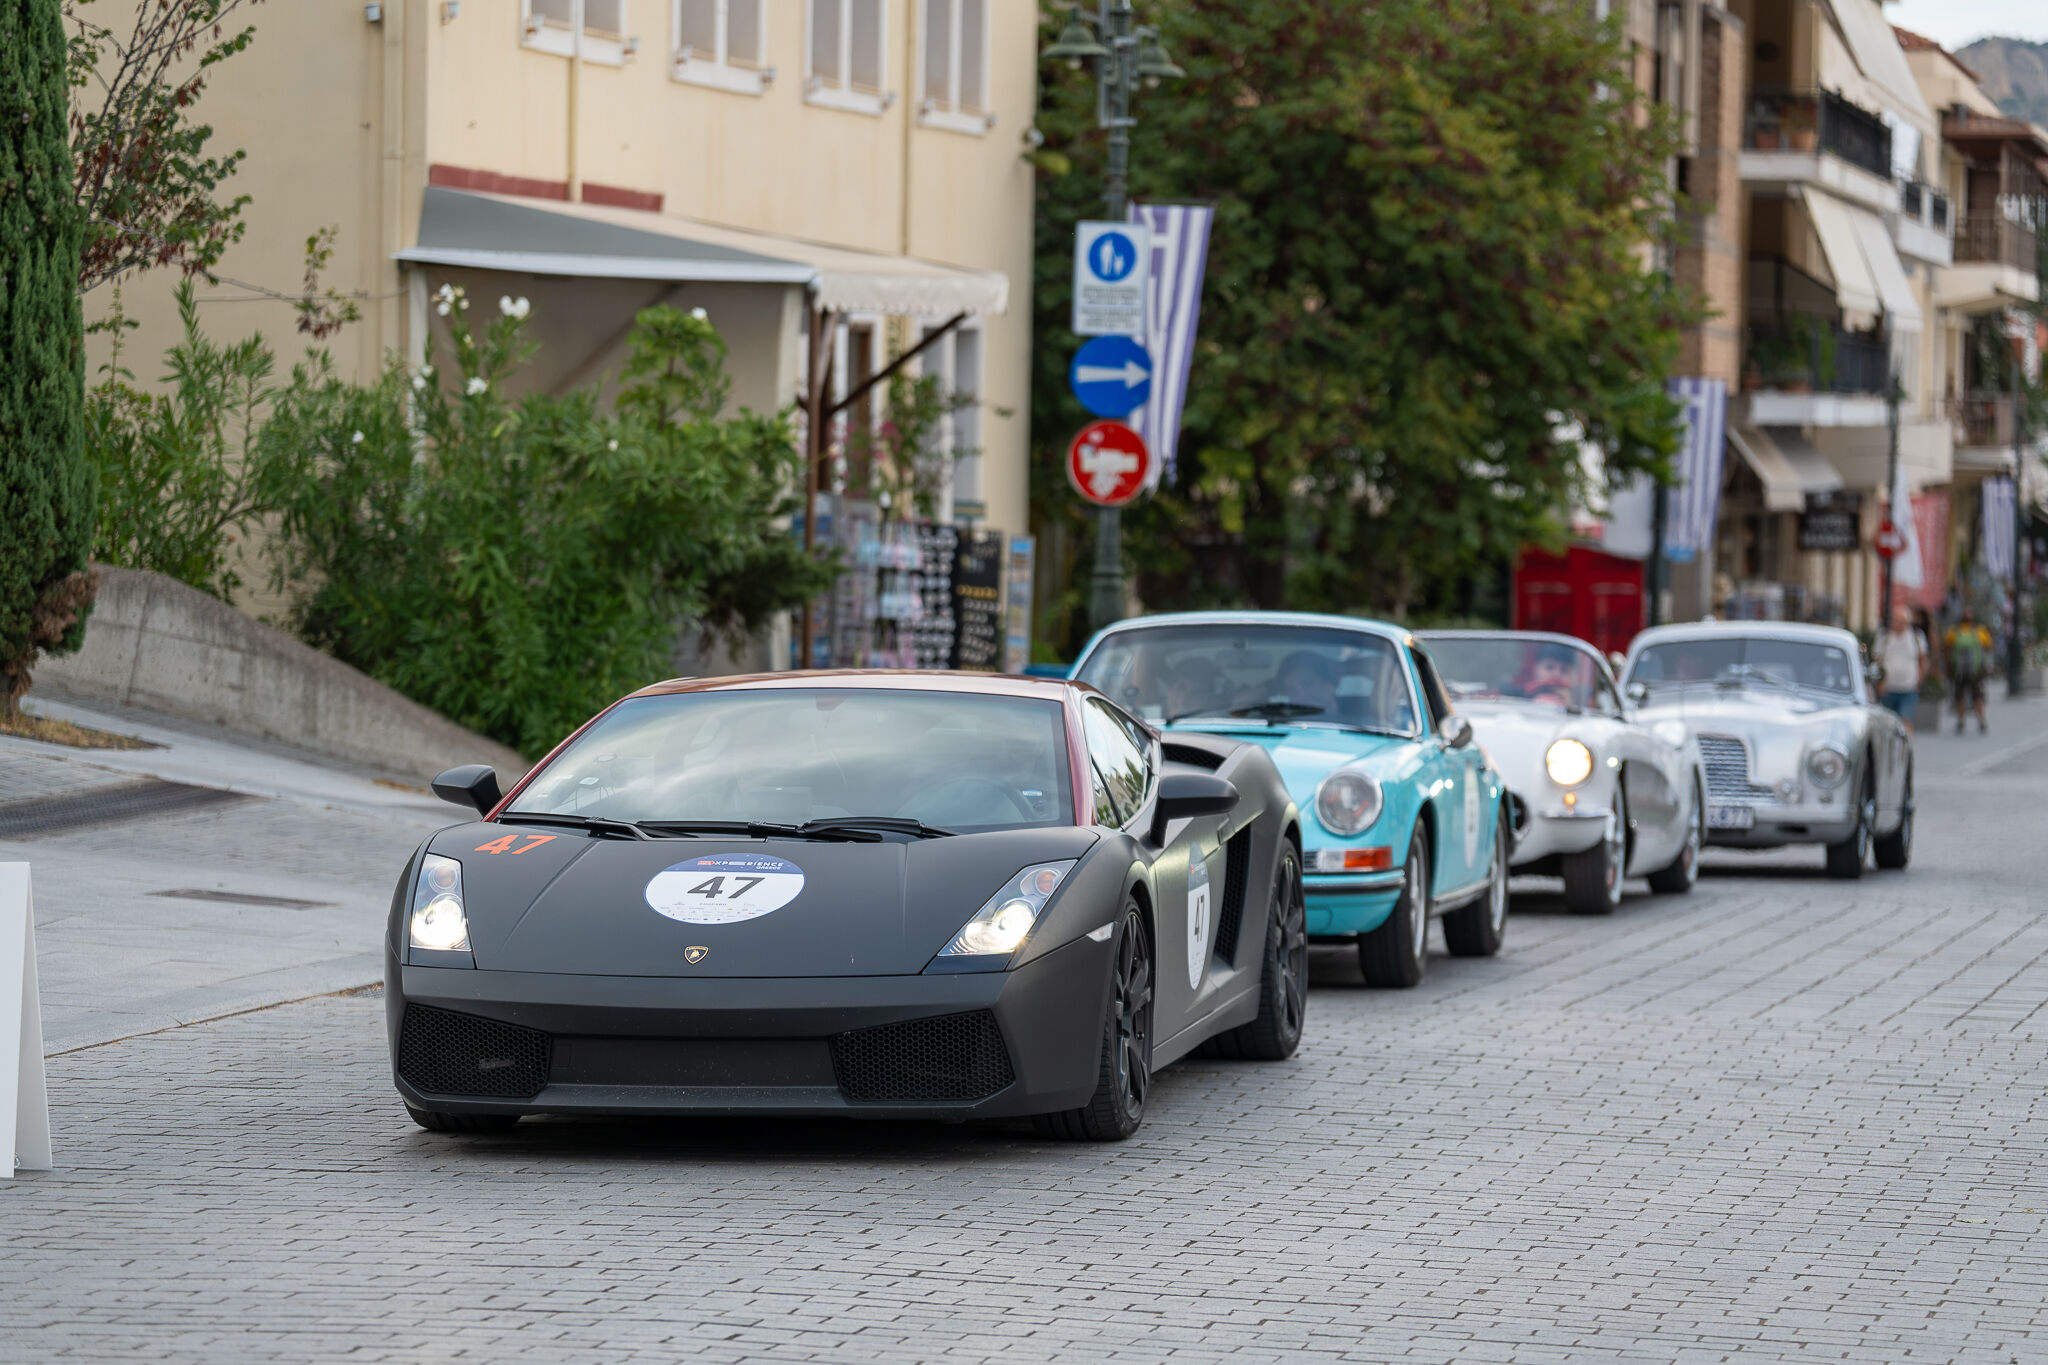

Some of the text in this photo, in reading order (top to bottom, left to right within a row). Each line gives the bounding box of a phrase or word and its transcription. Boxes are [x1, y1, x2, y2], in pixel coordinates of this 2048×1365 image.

[474, 834, 558, 855] 47
[687, 876, 766, 899] 47
[1194, 894, 1205, 943] 47
